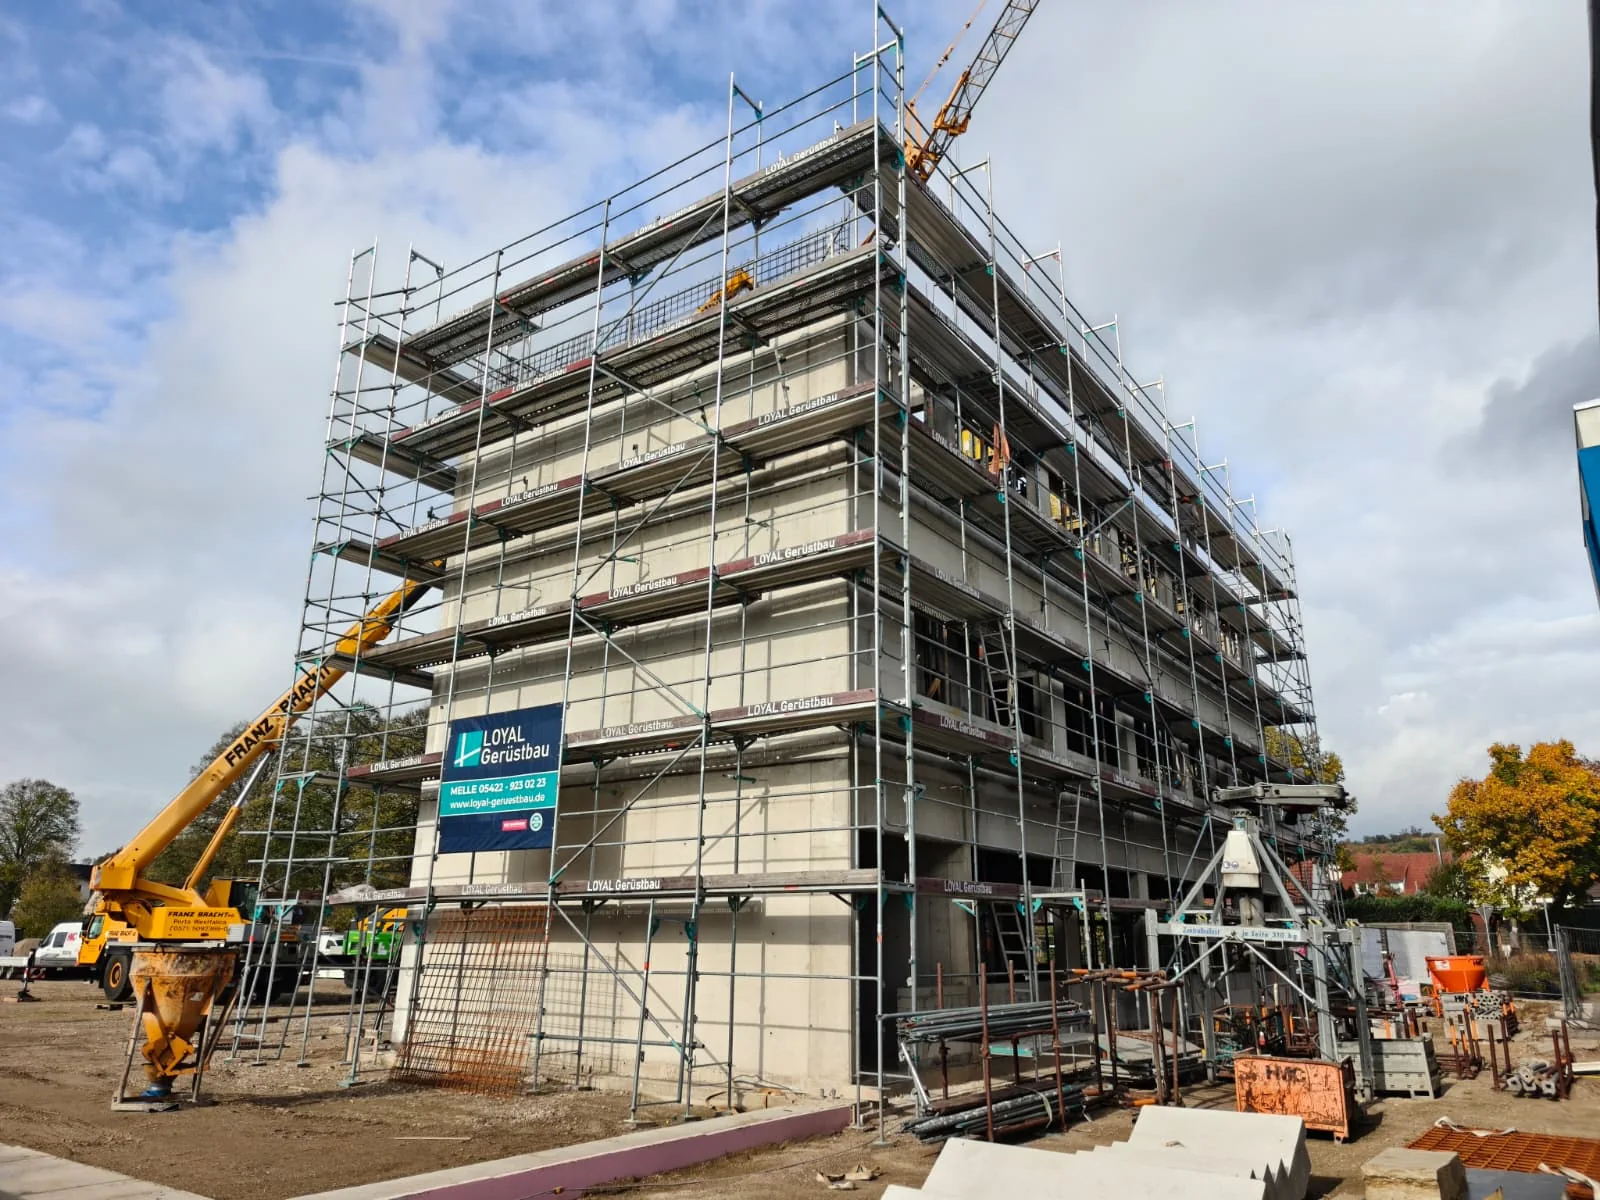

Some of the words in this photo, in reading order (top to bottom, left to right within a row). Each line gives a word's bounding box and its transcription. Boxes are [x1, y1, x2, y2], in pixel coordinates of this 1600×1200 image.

[765, 157, 793, 175] LOYAL
[794, 135, 839, 161] Gerüstbau
[758, 410, 788, 425] LOYAL
[789, 393, 838, 415] Gerüstbau
[619, 456, 643, 470] LOYAL
[501, 495, 522, 506] LOYAL
[523, 484, 559, 499] Gerüstbau
[400, 528, 418, 540] LOYAL
[753, 551, 784, 566] LOYAL
[785, 539, 835, 558] Gerüstbau
[608, 586, 633, 600] LOYAL
[635, 576, 677, 593] Gerüstbau
[488, 615, 510, 627] LOYAL
[747, 702, 778, 716] LOYAL
[781, 695, 833, 712] Gerüstbau
[224, 717, 274, 767] FRANZ
[483, 725, 526, 747] LOYAL
[601, 727, 627, 738] LOYAL
[481, 743, 550, 765] Gerüstbau
[370, 760, 389, 772] LOYAL
[450, 785, 478, 796] MELLE
[478, 783, 504, 793] 05422
[509, 781, 523, 791] 923
[524, 779, 535, 789] 02
[536, 777, 546, 788] 23
[450, 792, 546, 809] www.loyal-geruestbau.de
[586, 879, 614, 892] LOYAL
[615, 878, 660, 891] Gerüstbau
